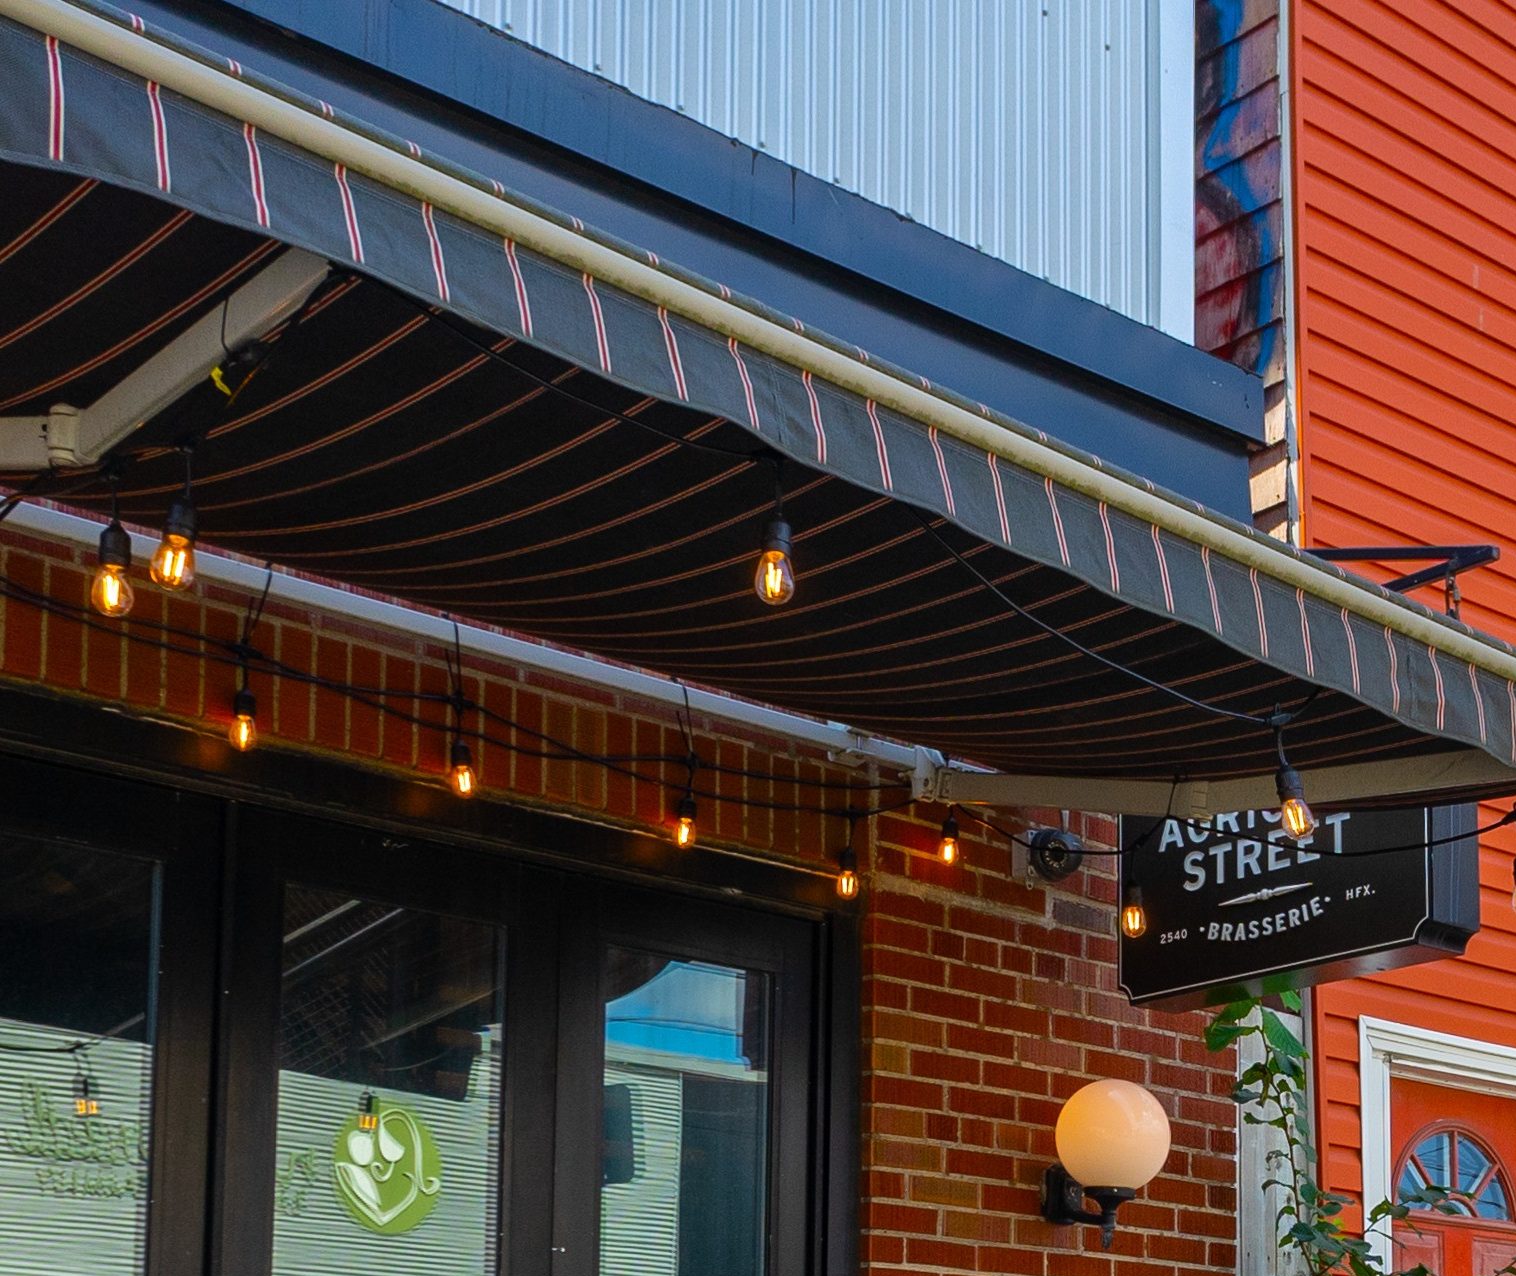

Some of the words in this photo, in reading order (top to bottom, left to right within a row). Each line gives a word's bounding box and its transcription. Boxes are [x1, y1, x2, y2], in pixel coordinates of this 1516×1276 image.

[1183, 812, 1350, 892] STREET
[1160, 929, 1188, 944] 2540
[1207, 896, 1324, 942] BRASSERIE
[1345, 884, 1376, 901] HFX.
